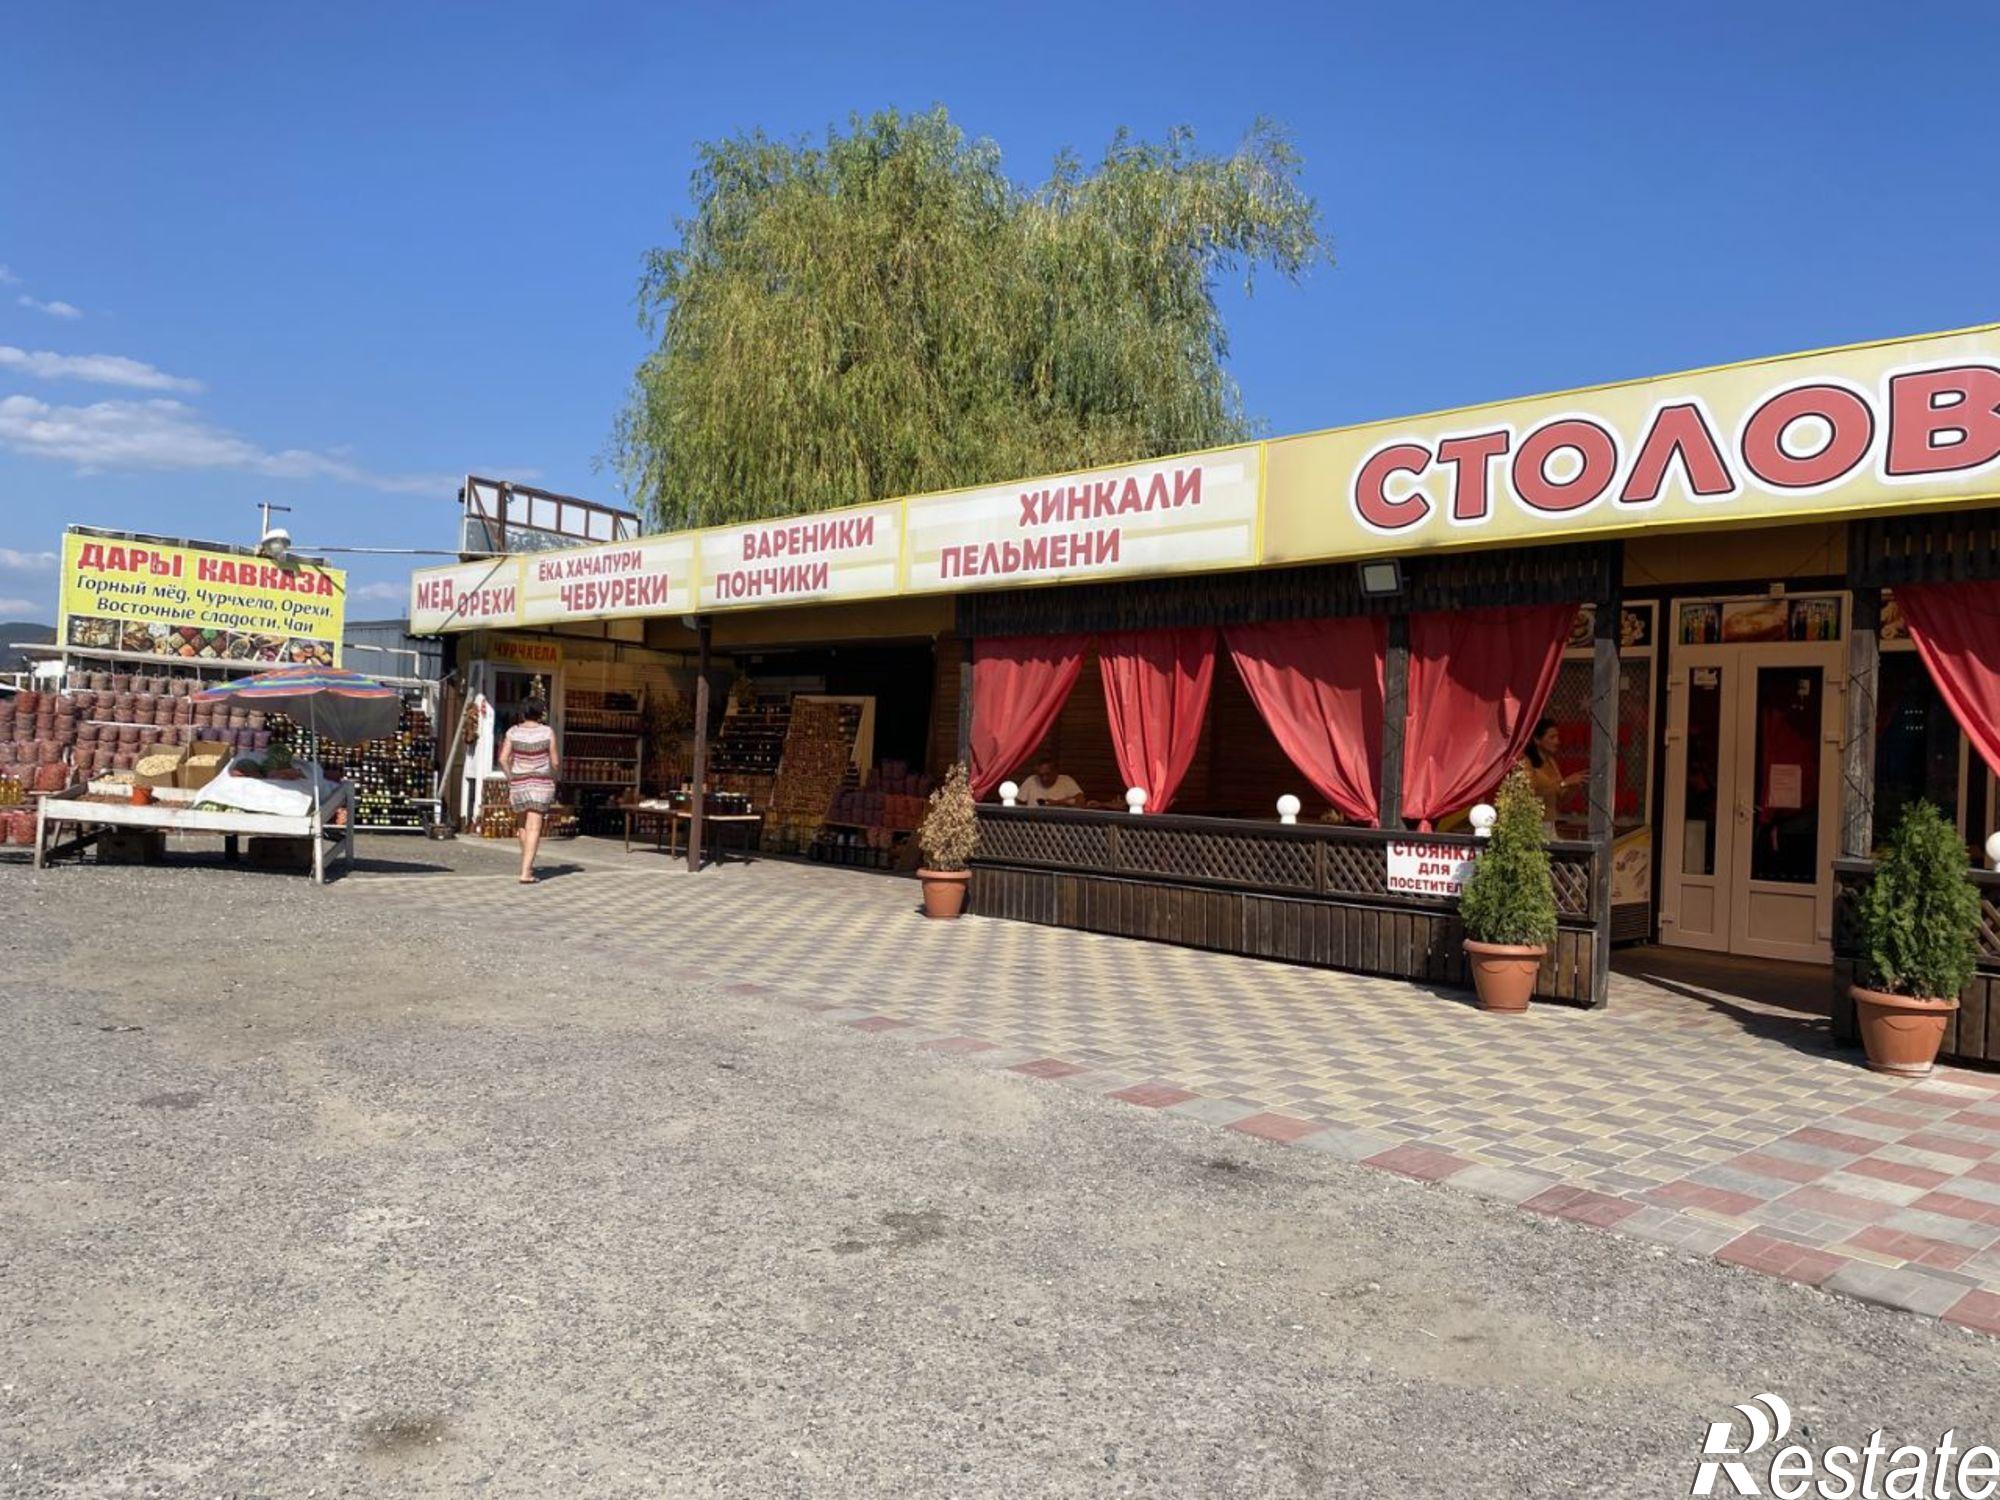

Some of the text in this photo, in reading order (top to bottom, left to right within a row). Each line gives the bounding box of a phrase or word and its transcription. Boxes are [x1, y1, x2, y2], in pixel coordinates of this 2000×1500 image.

[1019, 467, 1202, 527] ХИНКАЛИ
[743, 516, 874, 561] ВАРЕНИКИ
[941, 527, 1120, 579] ПЕЛЬМЕНИ
[77, 543, 334, 597] ДАРЫ КАВКАЗА
[567, 550, 642, 578] ХАЧАПУРИ
[716, 562, 828, 599] ПОНЧИКИ
[77, 575, 146, 594] Горный
[152, 584, 191, 604] мёд,
[458, 586, 516, 618] ОРЕХИ
[560, 574, 668, 612] ЧЕБУРЕКИ
[97, 597, 196, 619] Восточные
[1390, 877, 1463, 893] ПОСЕТИТЕЛ
[1418, 862, 1450, 876] ДЛЯ
